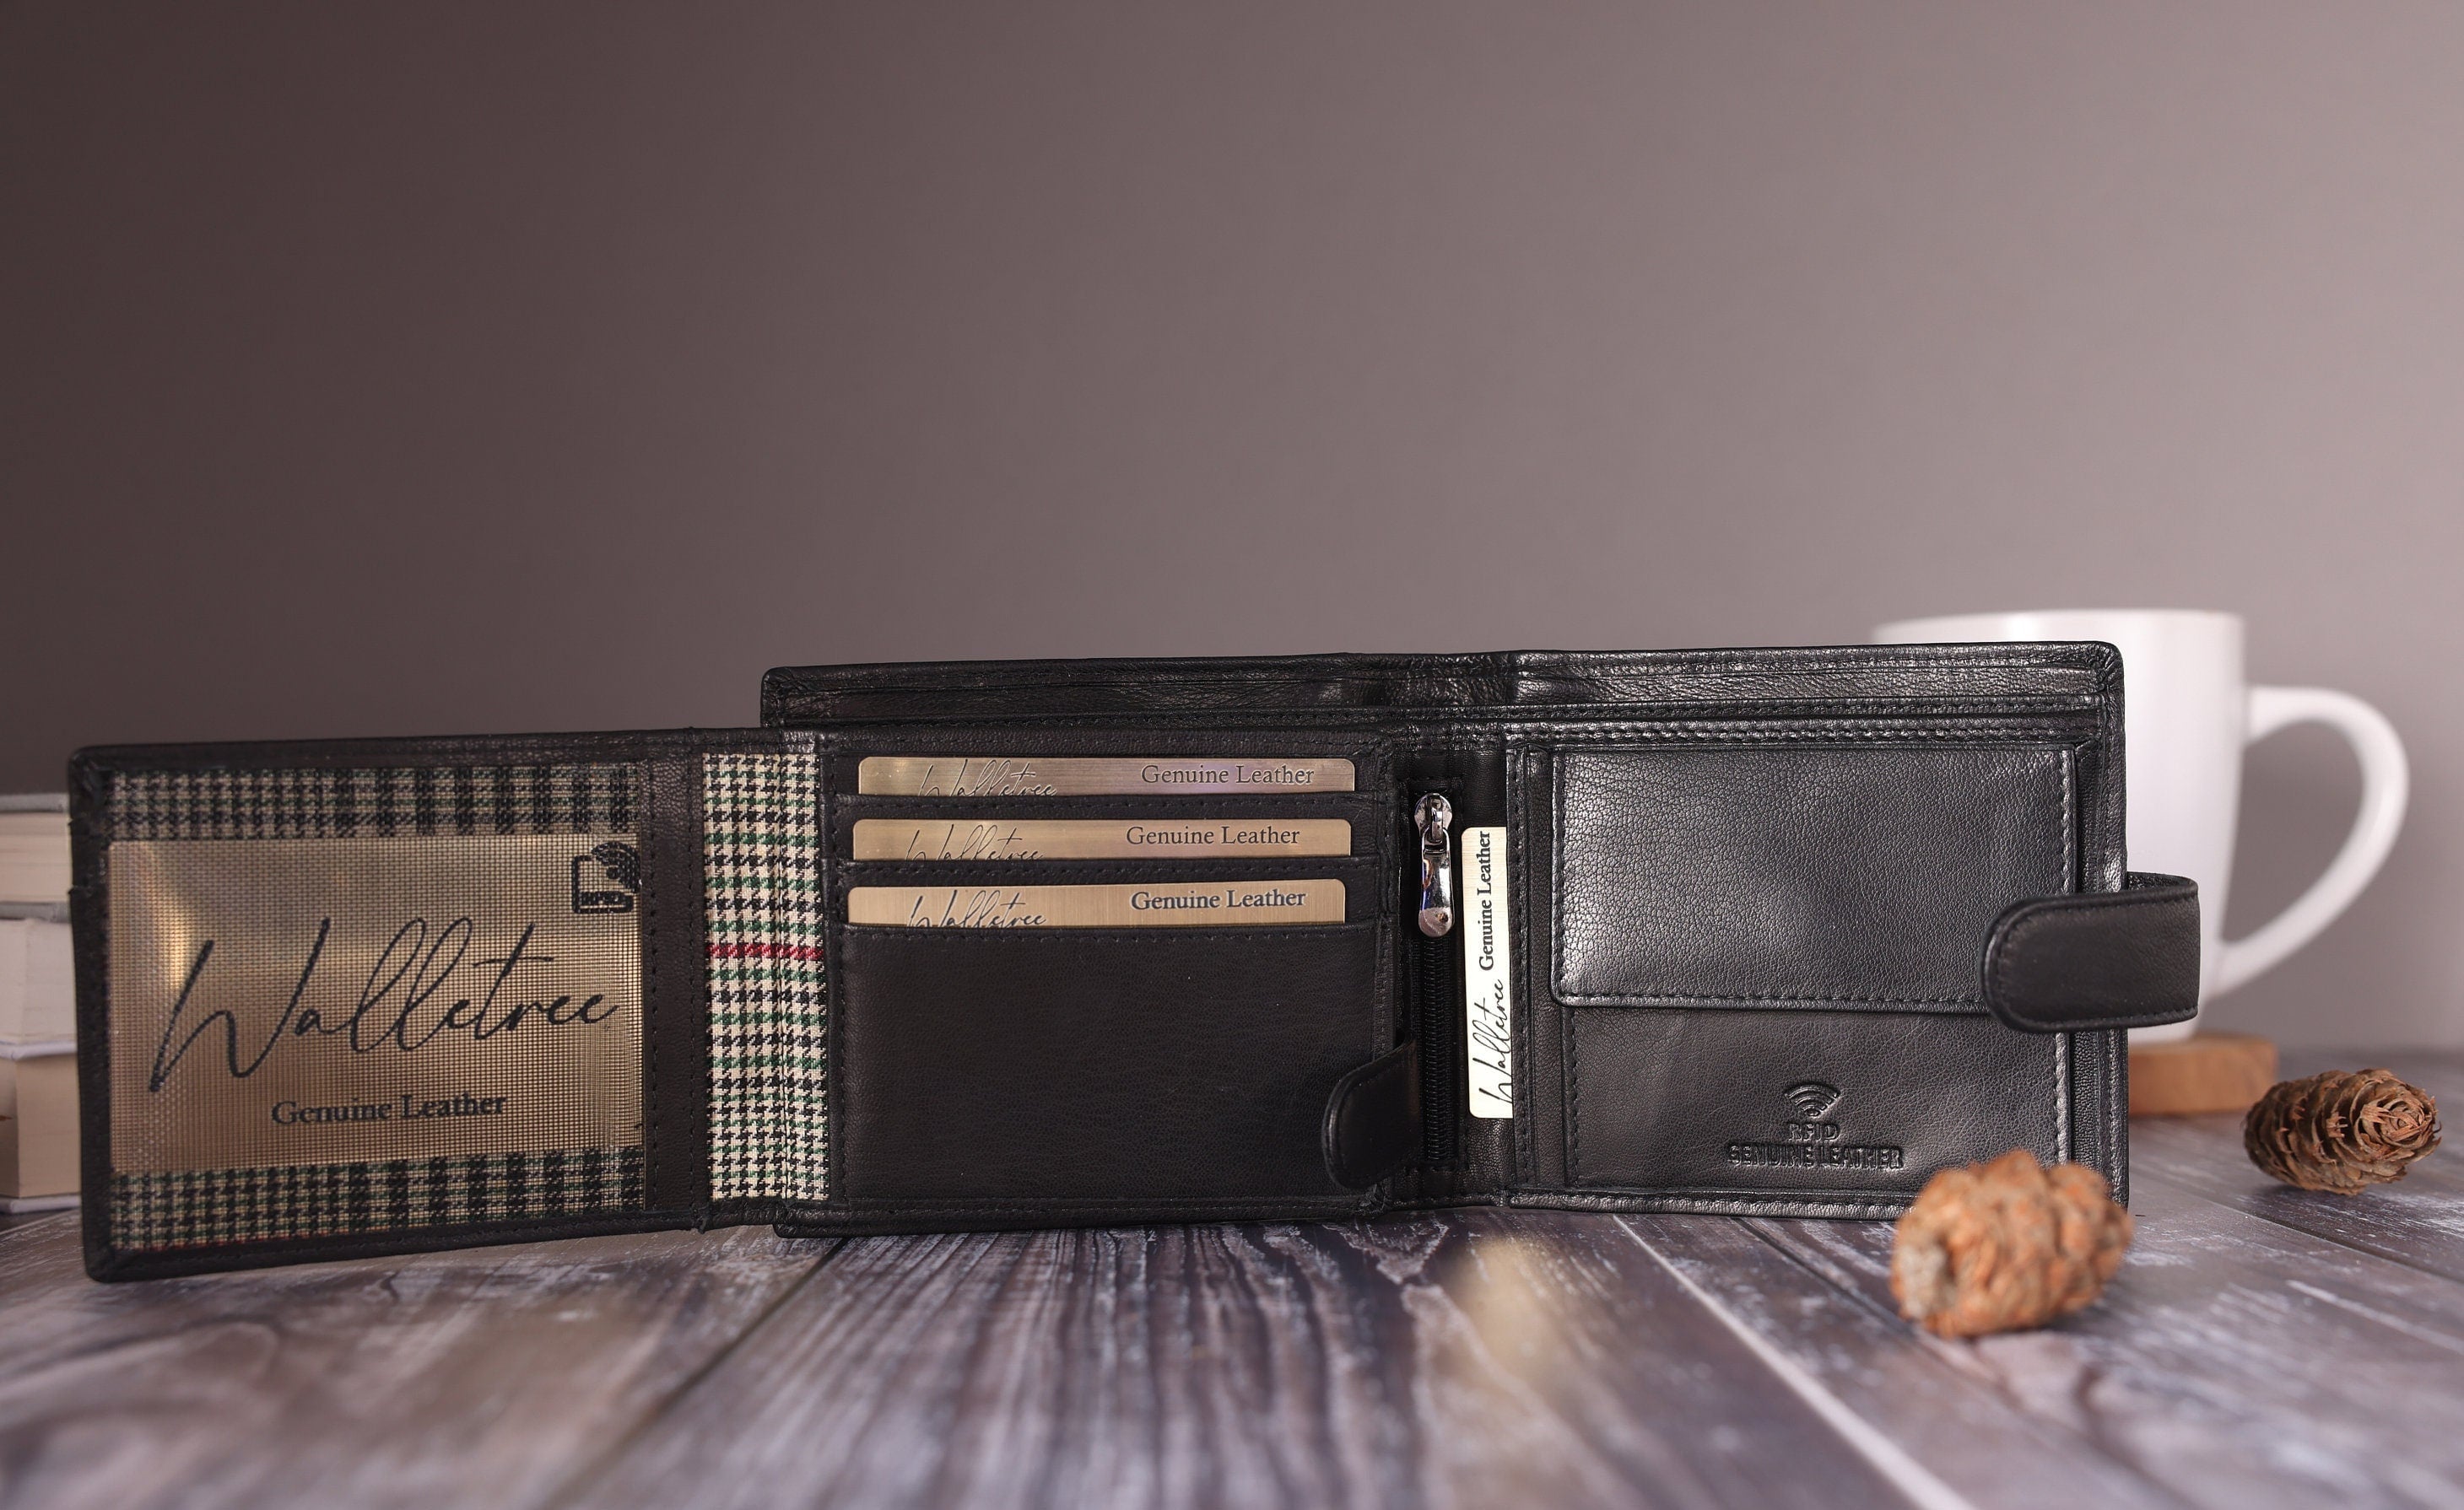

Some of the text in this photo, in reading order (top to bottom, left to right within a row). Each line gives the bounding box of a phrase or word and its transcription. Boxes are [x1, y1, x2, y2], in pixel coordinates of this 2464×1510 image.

[1141, 763, 1315, 784] Genuine Leather
[1127, 825, 1300, 844] Genuine Leather
[1476, 831, 1492, 897] Leather
[1131, 888, 1306, 910] Genuine Leather
[1478, 899, 1494, 971] Genuine
[149, 918, 620, 1092] Walletree
[272, 1092, 505, 1124] Genuine Leather
[1788, 1123, 1840, 1141] RFID
[1729, 1144, 1904, 1170] GENUINE LEATHER
